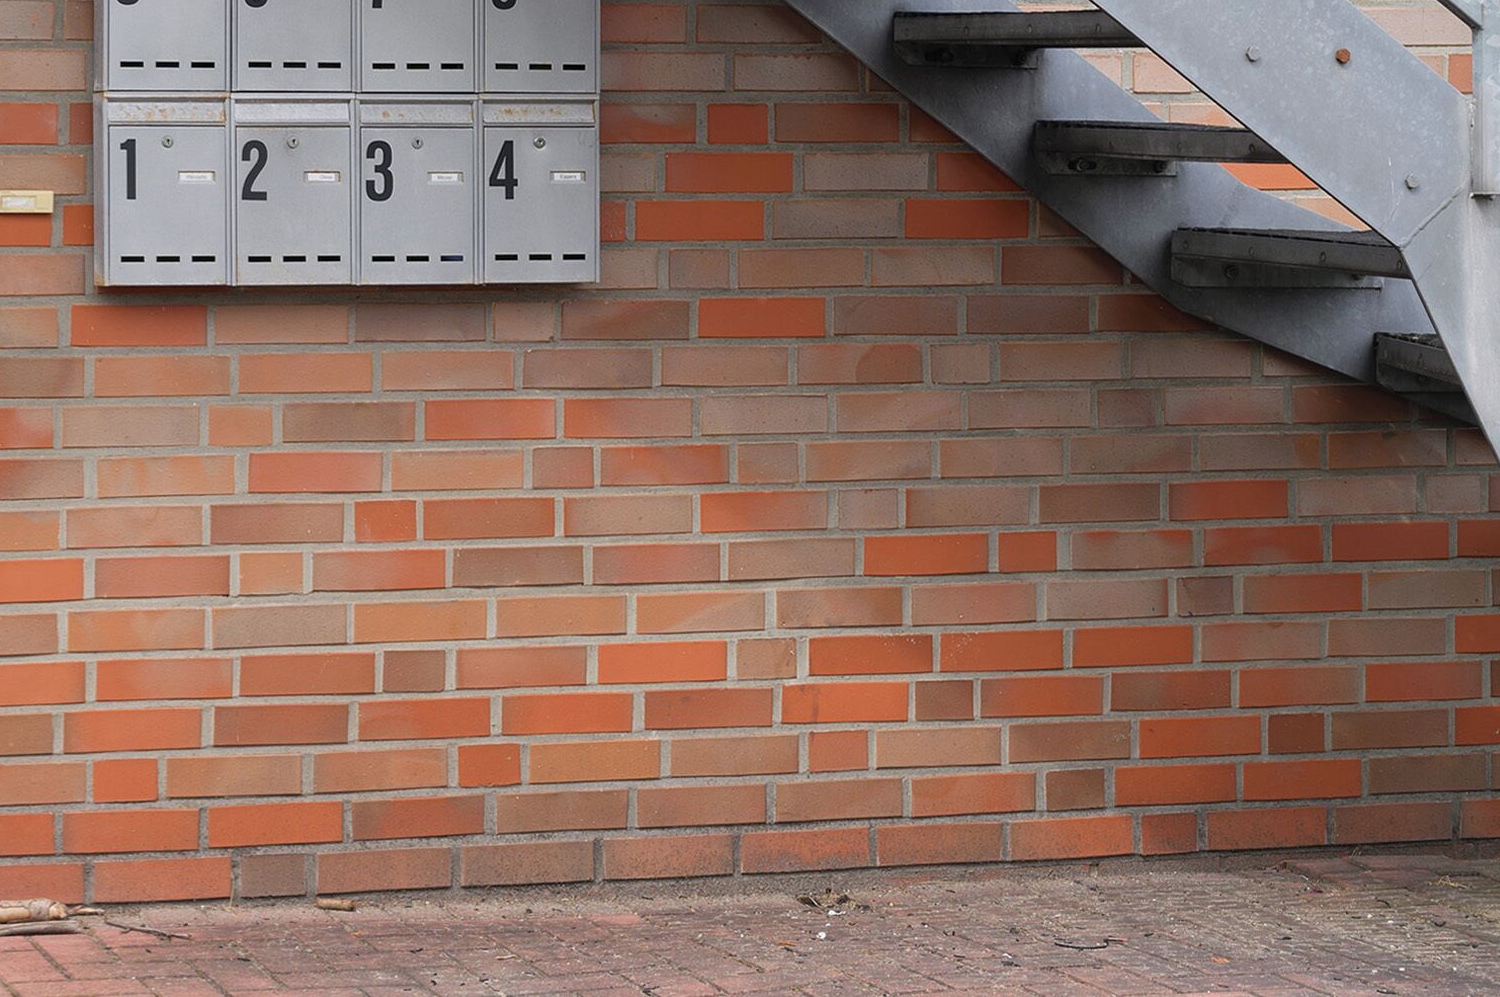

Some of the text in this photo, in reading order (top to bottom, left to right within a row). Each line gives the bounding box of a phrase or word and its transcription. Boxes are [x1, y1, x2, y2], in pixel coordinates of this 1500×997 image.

[120, 138, 137, 200] 1
[241, 139, 268, 201] 2
[365, 140, 394, 202] 3
[488, 139, 519, 200] 4
